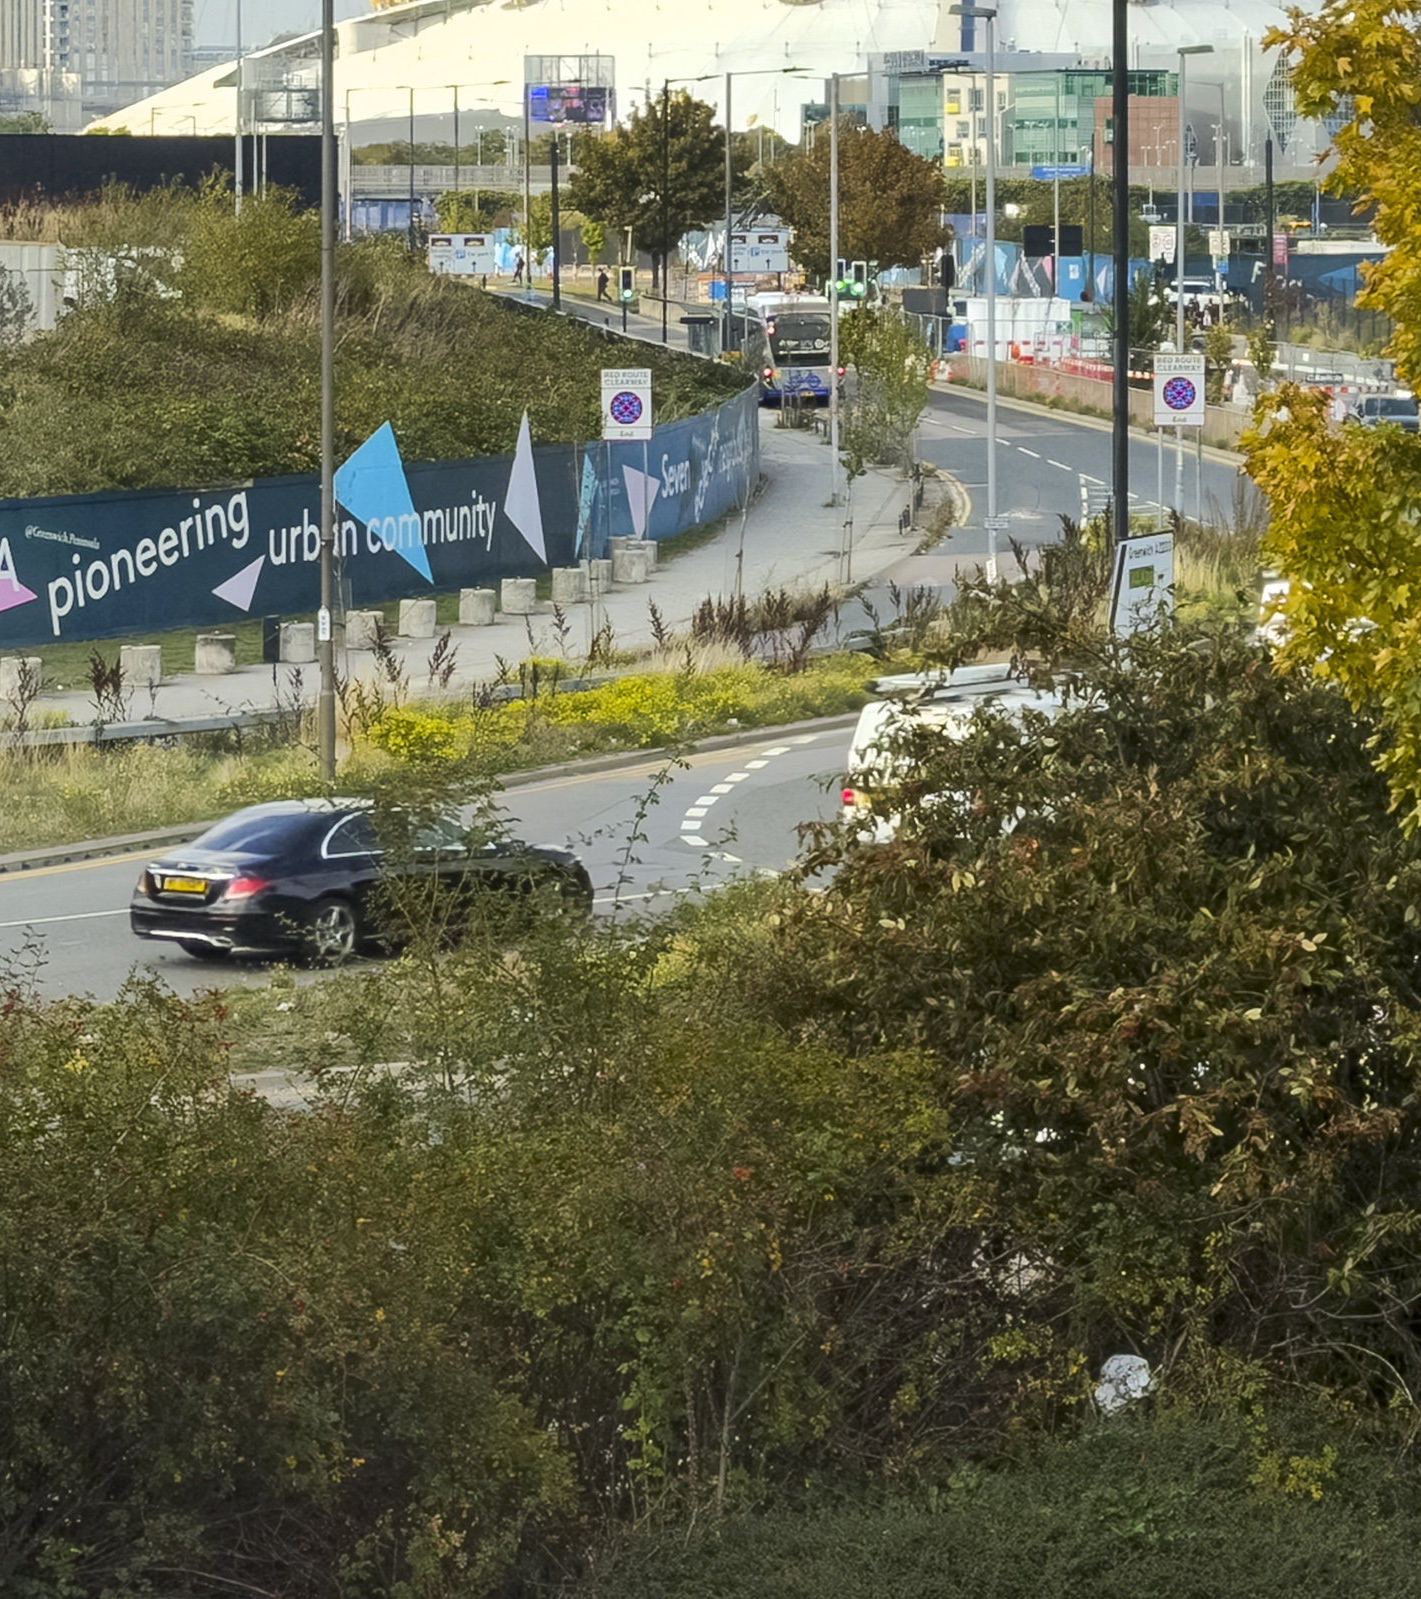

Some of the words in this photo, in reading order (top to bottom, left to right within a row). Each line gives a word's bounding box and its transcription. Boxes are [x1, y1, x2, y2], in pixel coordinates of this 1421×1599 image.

[1157, 356, 1173, 364] RED
[1175, 356, 1202, 364] ROUTE
[661, 453, 691, 498] Seven
[48, 491, 250, 636] pioneering
[366, 489, 496, 554] community
